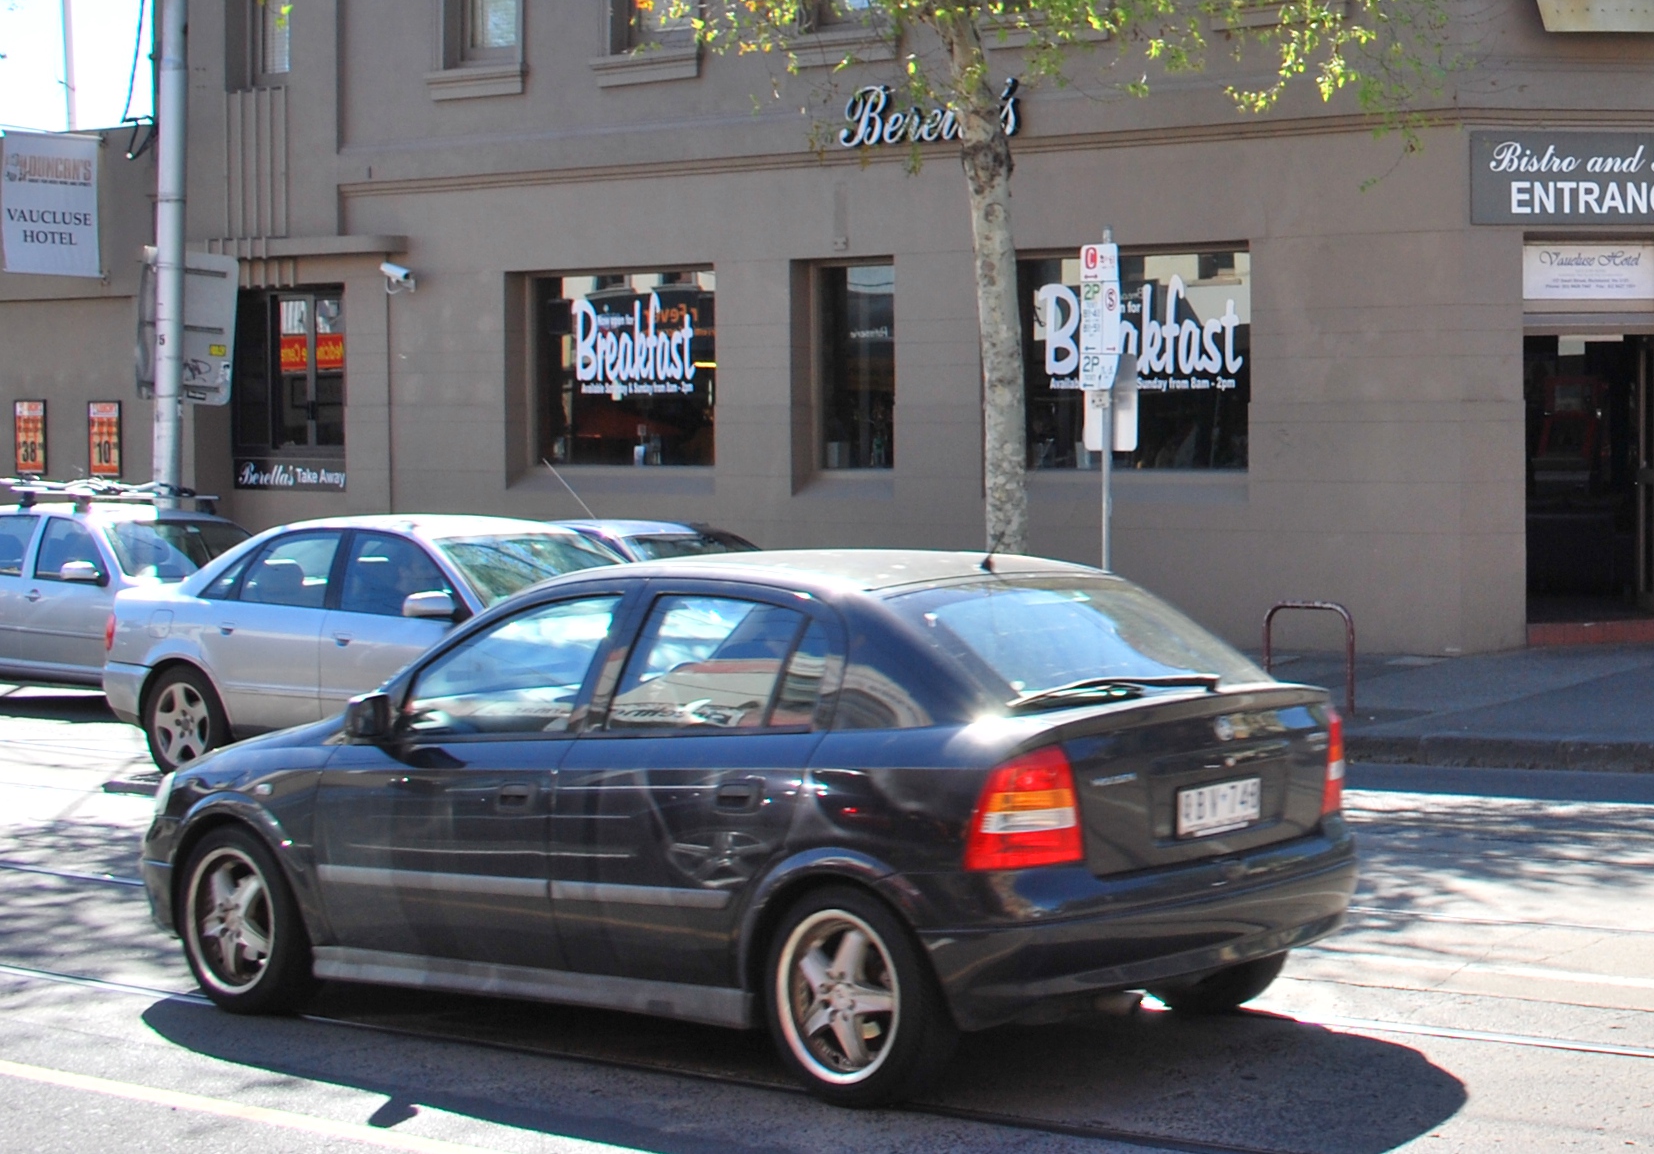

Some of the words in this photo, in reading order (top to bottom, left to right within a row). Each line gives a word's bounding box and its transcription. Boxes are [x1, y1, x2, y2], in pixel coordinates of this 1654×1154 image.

[1490, 141, 1581, 174] Bistro
[1586, 145, 1645, 173] and
[7, 208, 92, 226] VAUCLUSE
[23, 230, 77, 246] HOTEL
[1539, 250, 1596, 266] Vaucluse
[1597, 250, 1641, 266] Hotel
[1083, 283, 1100, 300] 2P
[1127, 301, 1141, 313] for
[1038, 274, 1243, 375] Bakfast
[571, 288, 696, 381] Breakfast
[1082, 355, 1100, 373] 2P
[1050, 377, 1080, 389] Availab
[1137, 377, 1168, 392] Sunday
[1169, 377, 1189, 390] from
[1190, 377, 1210, 390] 8am
[1216, 376, 1236, 392] 2pm
[295, 468, 318, 483] Take
[319, 468, 345, 488] Away
